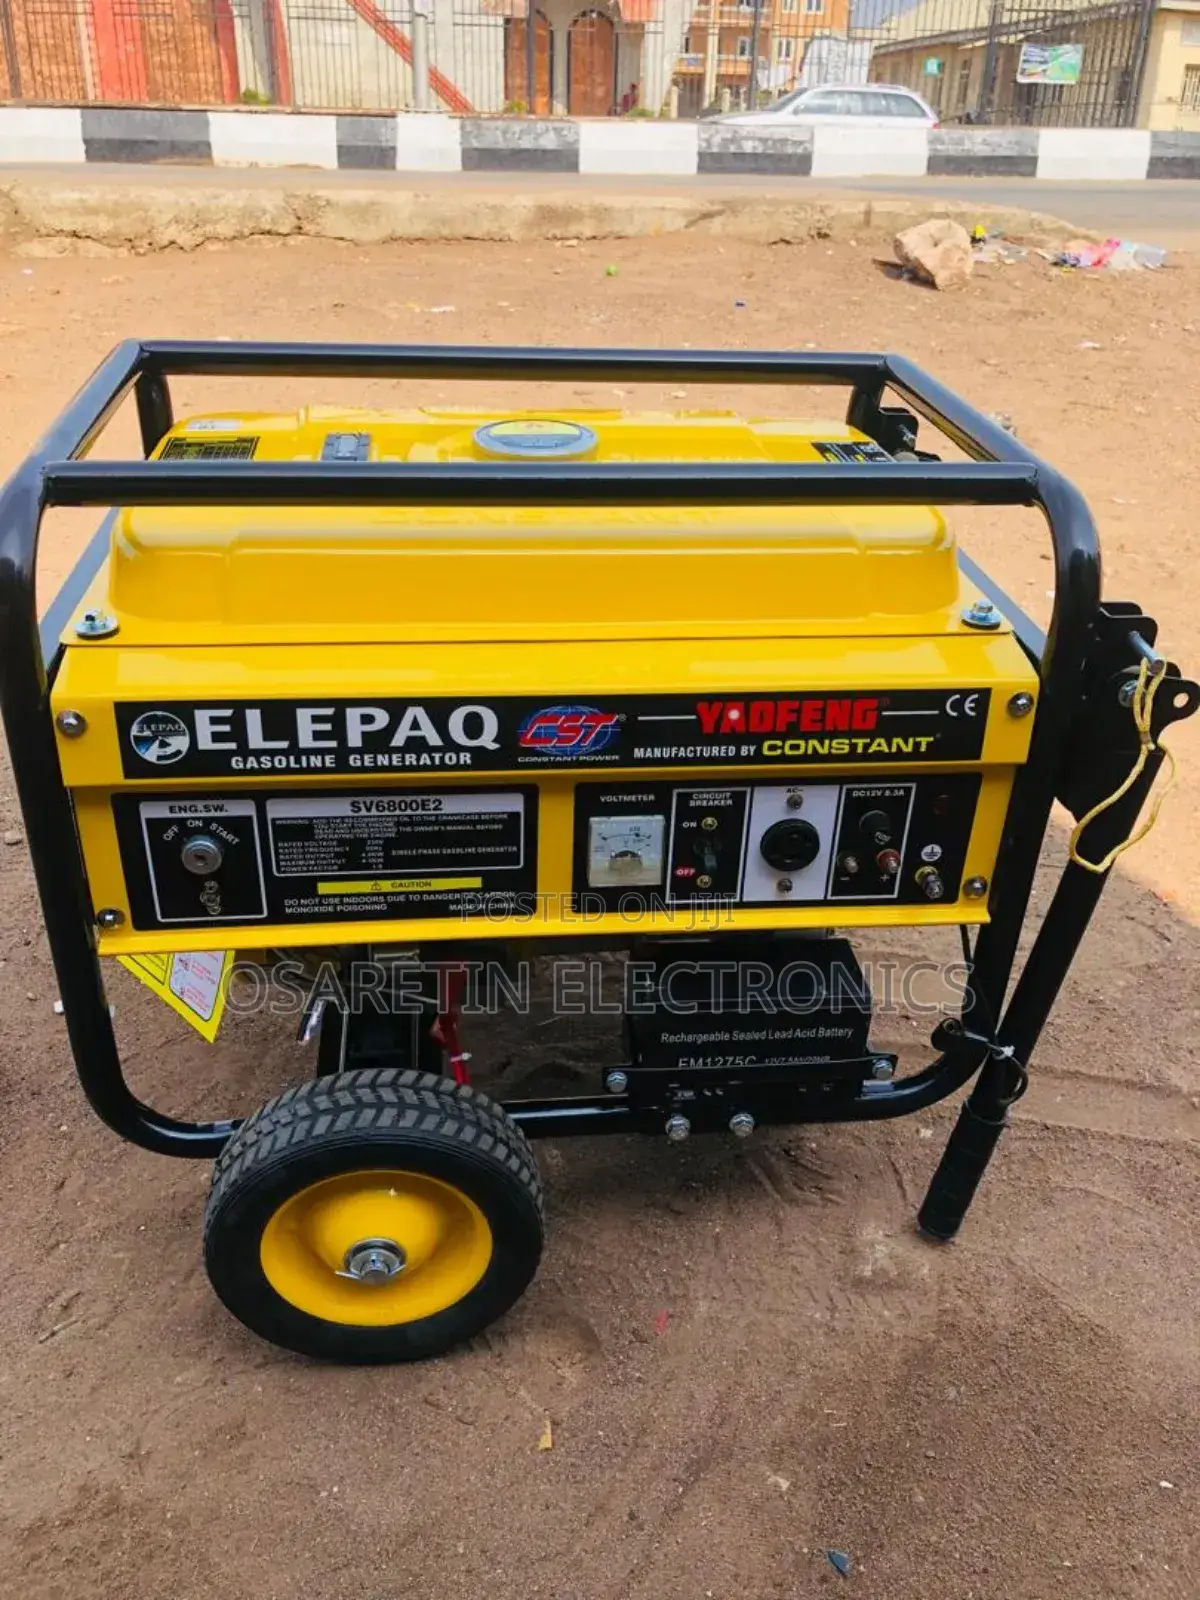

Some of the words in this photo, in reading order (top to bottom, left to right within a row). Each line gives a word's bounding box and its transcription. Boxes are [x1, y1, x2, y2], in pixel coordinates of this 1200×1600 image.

[696, 698, 879, 734] YAOFENG
[194, 704, 501, 750] ELEPAQ
[634, 745, 736, 760] MANUFACTURED
[740, 744, 757, 757] BY
[762, 736, 934, 756] CONSTANT
[231, 754, 336, 769] GASOLINE
[349, 752, 472, 767] GENERATOR
[579, 754, 620, 762] POWER
[600, 793, 656, 803] VOLTMETER
[692, 791, 731, 800] CIRCUIT
[852, 789, 883, 798] DC12V
[168, 803, 229, 815] ENG.SW.
[350, 798, 443, 813] SV6800E2
[689, 799, 733, 807] BREAKER
[187, 818, 204, 828] ON
[682, 821, 698, 829] ON
[163, 824, 180, 841] OFF
[209, 821, 240, 845] START
[675, 867, 695, 876] OFF
[391, 881, 432, 889] CAUTION
[284, 898, 299, 906] DO
[322, 897, 341, 905] USE
[343, 896, 385, 904] INDOORS
[422, 892, 461, 901] DANGER
[285, 904, 335, 914] MONOXIDE
[336, 903, 388, 913] POISONING
[660, 1030, 731, 1045] Rechargeable
[732, 1029, 767, 1041] Sealed
[768, 1028, 794, 1040] Lead
[794, 1027, 817, 1039] Acid
[817, 1026, 854, 1040] Battery
